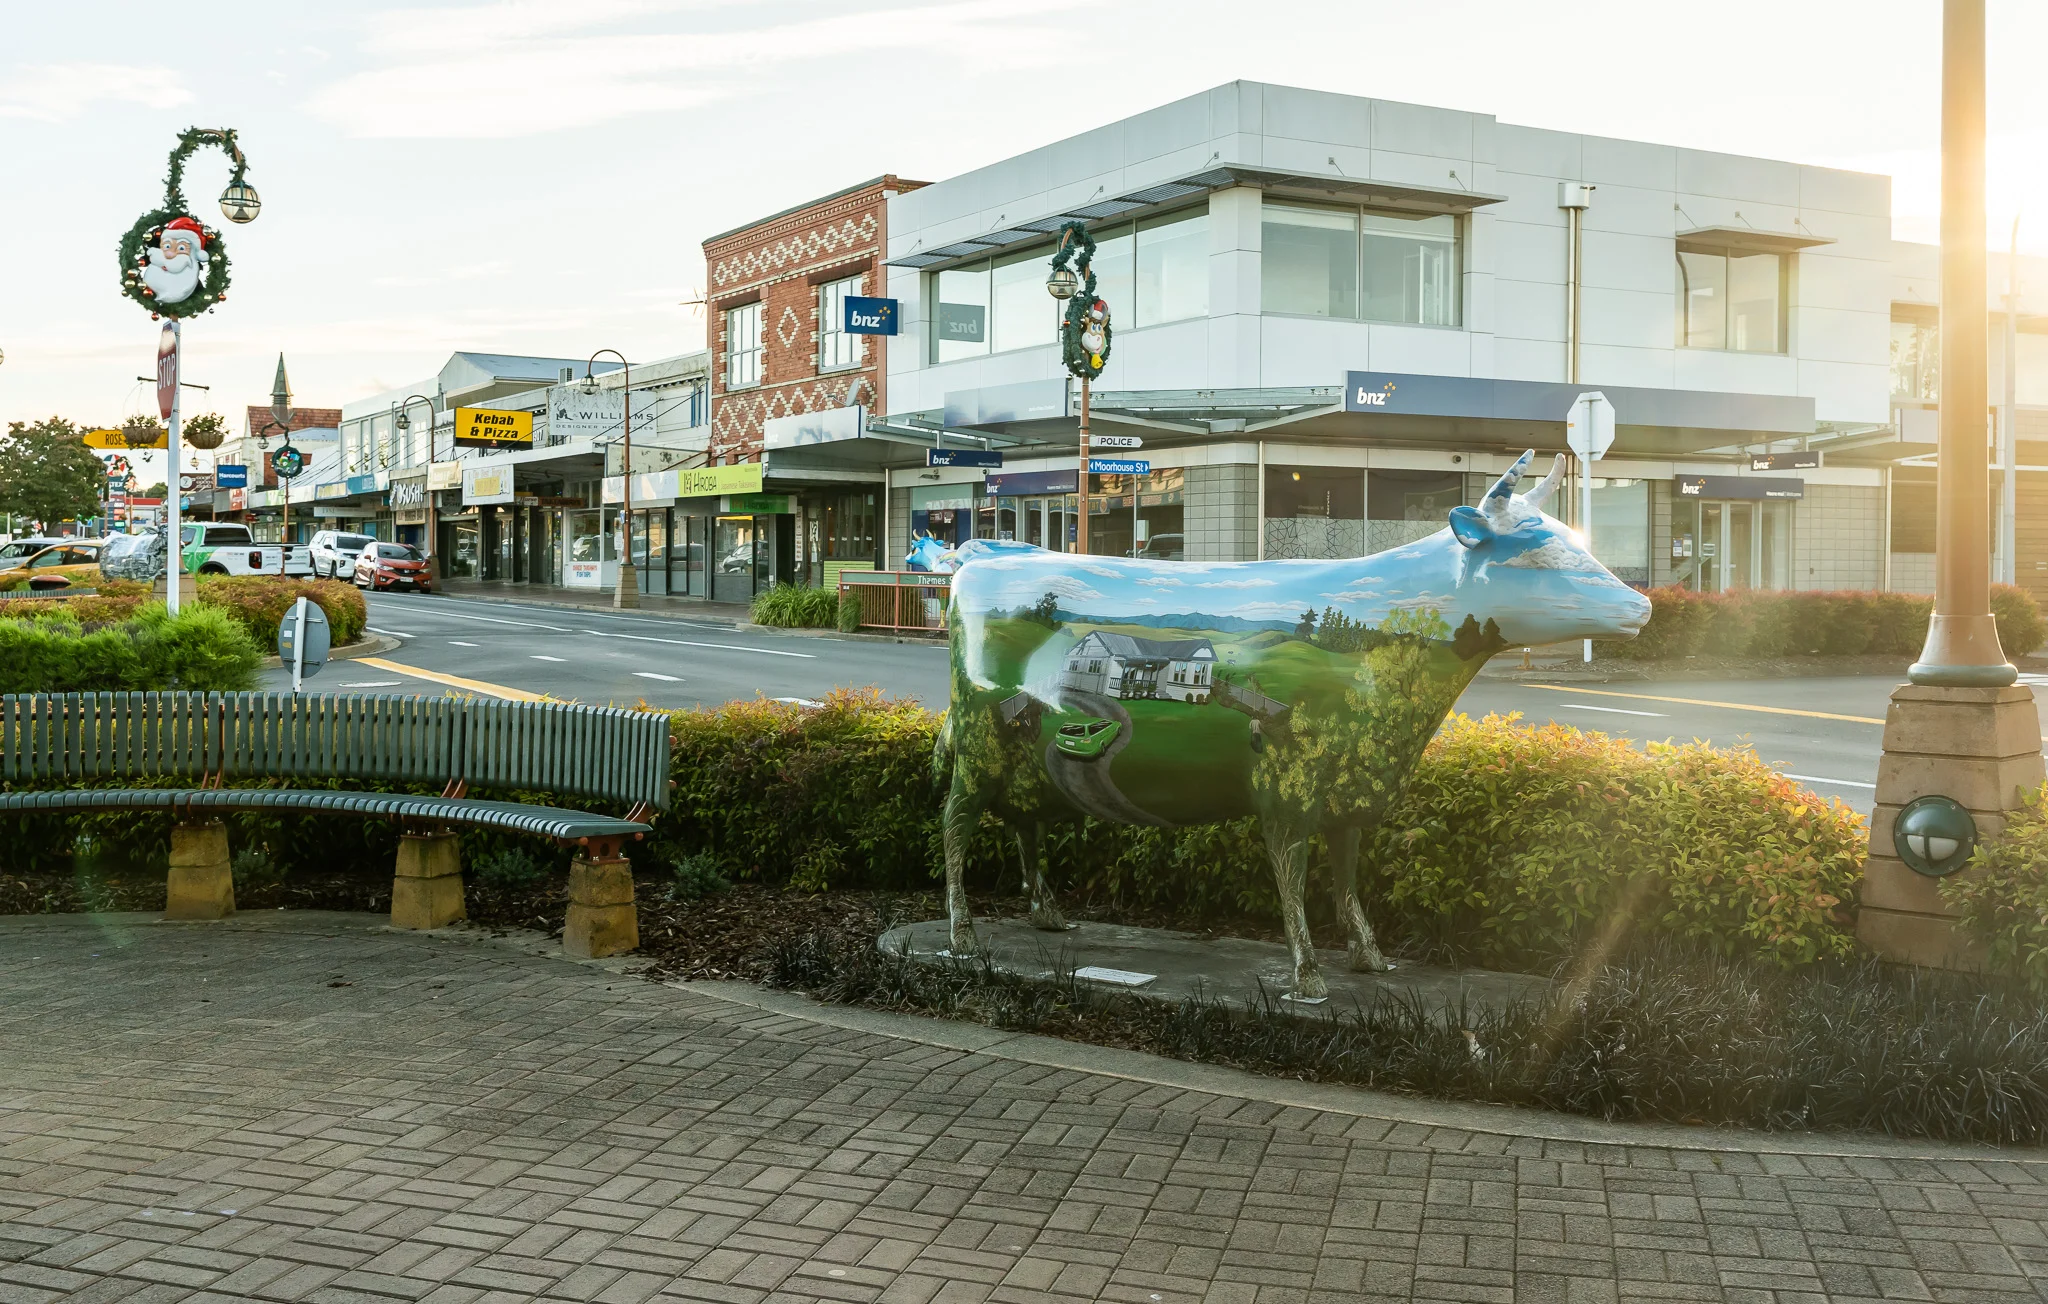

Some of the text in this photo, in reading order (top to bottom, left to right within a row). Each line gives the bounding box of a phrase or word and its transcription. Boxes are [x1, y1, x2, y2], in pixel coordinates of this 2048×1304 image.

[851, 311, 880, 328] bnz
[158, 353, 176, 390] STOP
[1356, 387, 1386, 405] bnz
[474, 413, 515, 426] Kebab
[579, 411, 653, 421] WILLIMS
[470, 426, 518, 439] & Pizza
[105, 433, 122, 446] ROSE
[1100, 437, 1133, 446] POLICE
[933, 455, 950, 465] bnz
[1753, 460, 1770, 470] bnz
[1094, 461, 1144, 472] Moorhouse St
[986, 483, 998, 493] bnz
[1682, 482, 1700, 495] bnz
[917, 575, 946, 585] Thames
